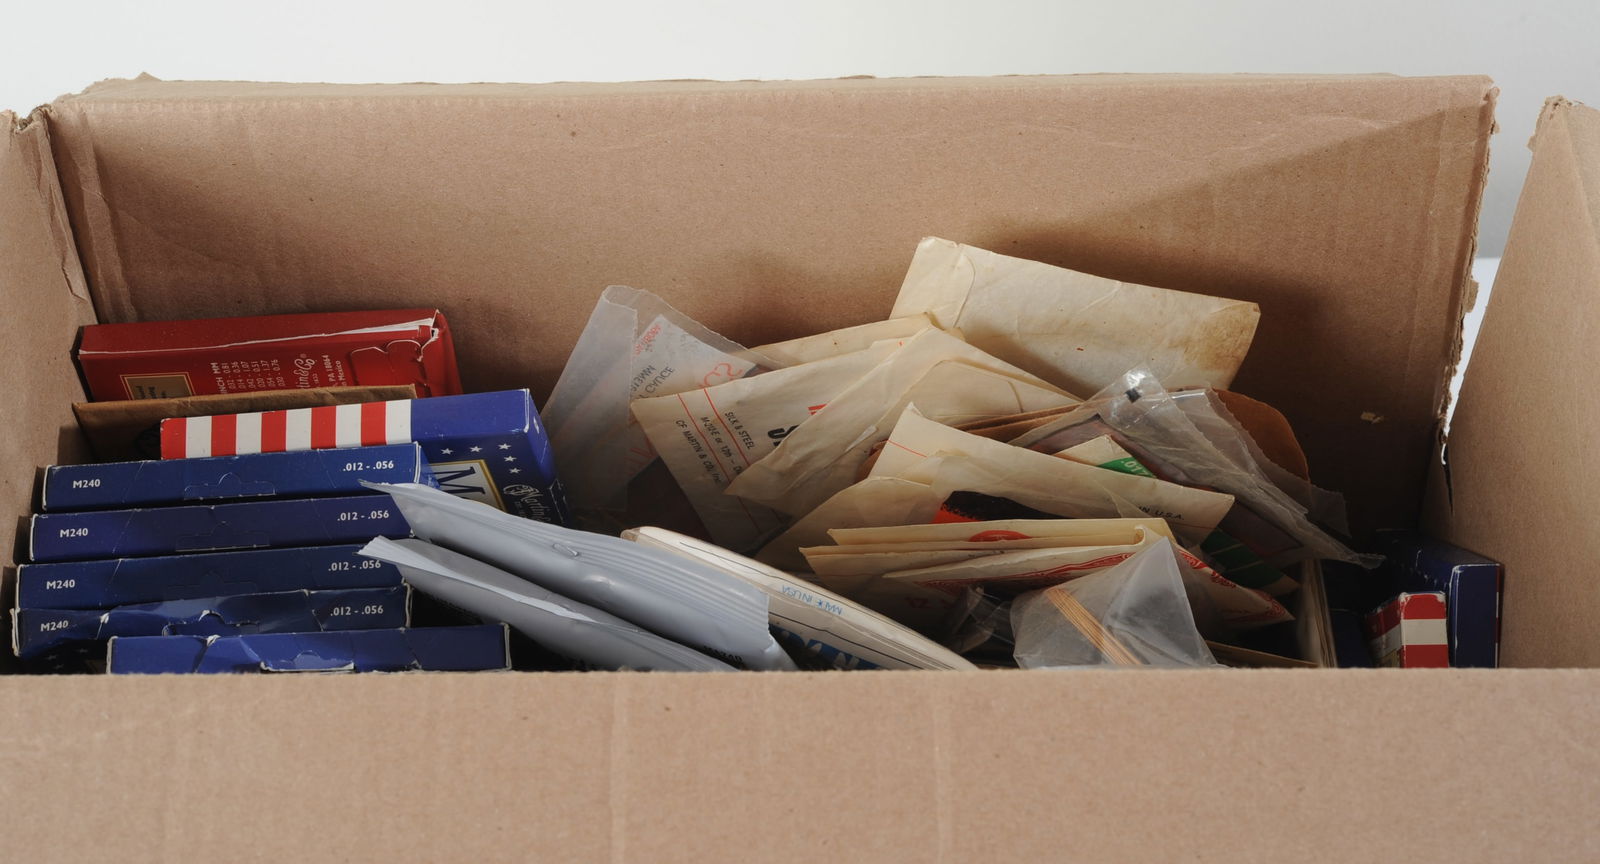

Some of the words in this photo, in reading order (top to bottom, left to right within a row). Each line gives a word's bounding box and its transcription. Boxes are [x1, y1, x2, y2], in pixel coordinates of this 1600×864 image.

[210, 362, 221, 374] MM
[335, 360, 345, 381] Mexico
[216, 376, 228, 394] INCH
[683, 430, 704, 453] MARTIN
[739, 429, 755, 450] STEEL
[342, 462, 364, 472] .012
[373, 460, 394, 470] .056
[72, 478, 101, 489] M240
[337, 511, 359, 521] .012
[367, 510, 389, 519] .056
[59, 527, 89, 538] M240
[328, 562, 350, 571] .012
[359, 560, 381, 570] .056
[46, 579, 76, 590] M240
[330, 607, 352, 616] .012
[361, 605, 384, 615] .056
[40, 620, 69, 632] M240
